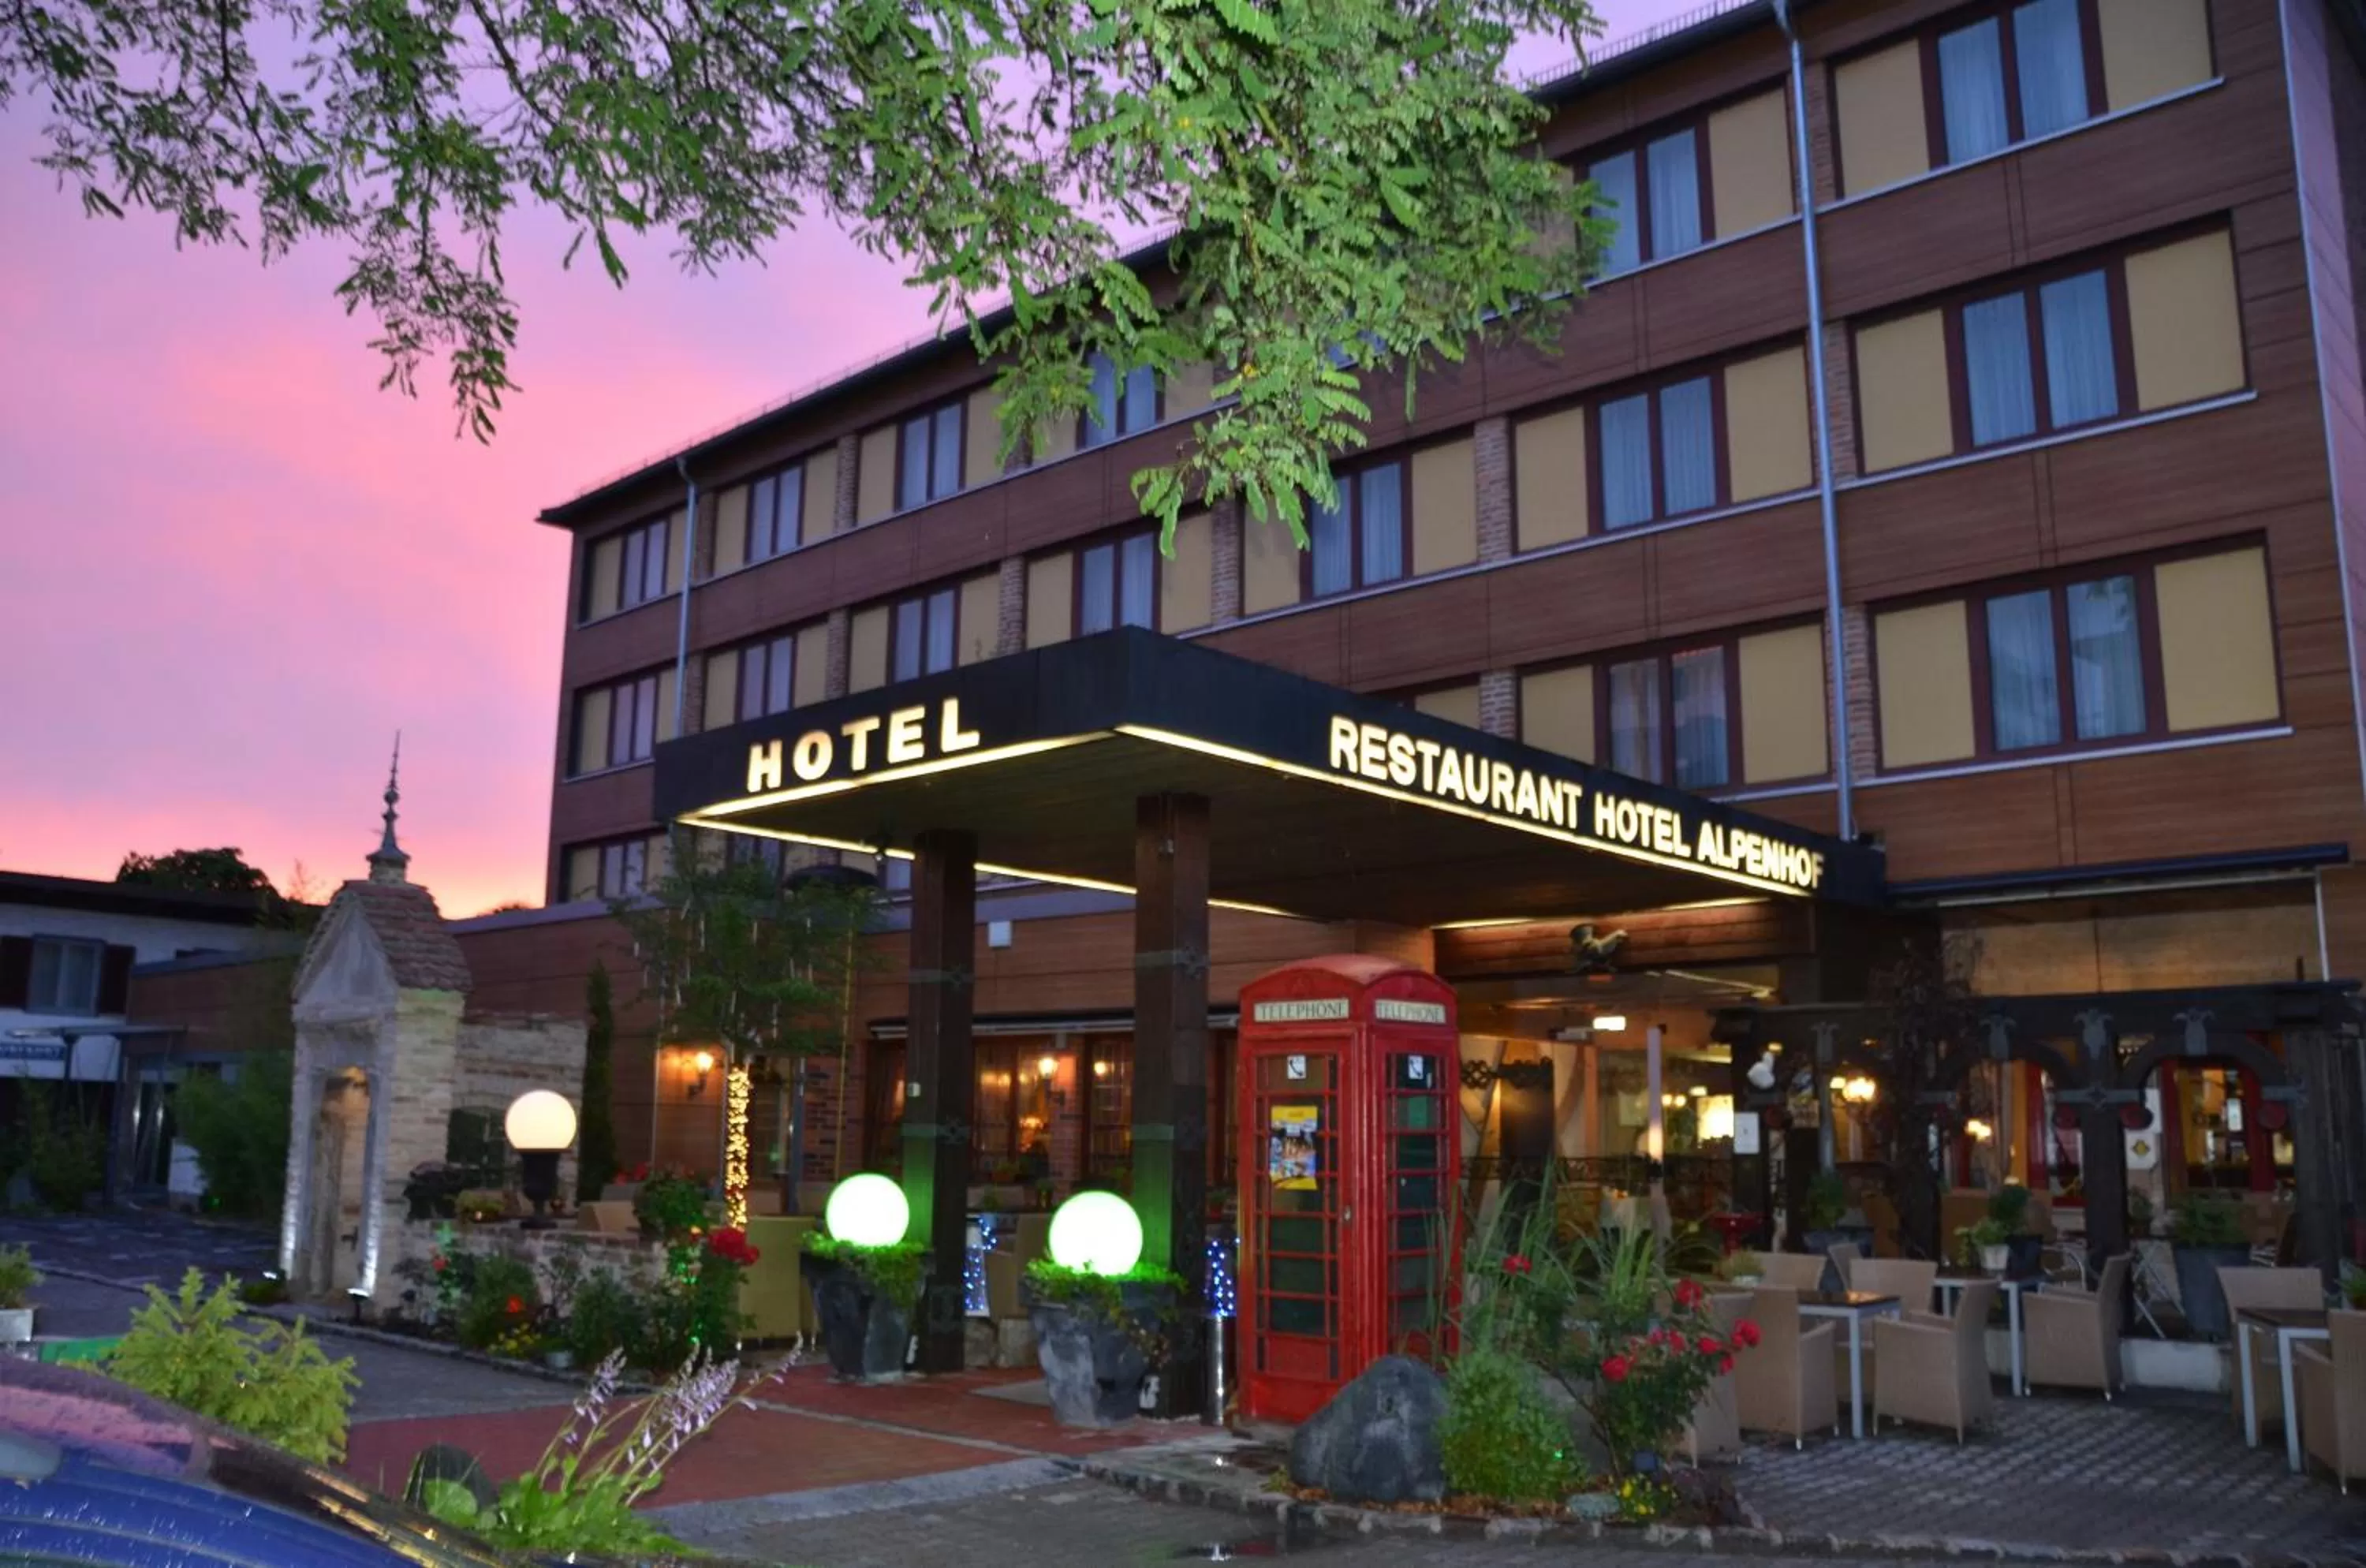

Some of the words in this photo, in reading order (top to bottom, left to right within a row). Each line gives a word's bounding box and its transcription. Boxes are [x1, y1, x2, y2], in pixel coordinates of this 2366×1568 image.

[747, 695, 980, 793] HOTEL
[1330, 715, 1582, 829] RESTAURANT
[1594, 791, 1692, 857] HOTEL
[1697, 820, 1823, 889] ALPENHOF
[1260, 1000, 1345, 1021] TELEPHONE
[1377, 1002, 1442, 1022] TELEPHONE
